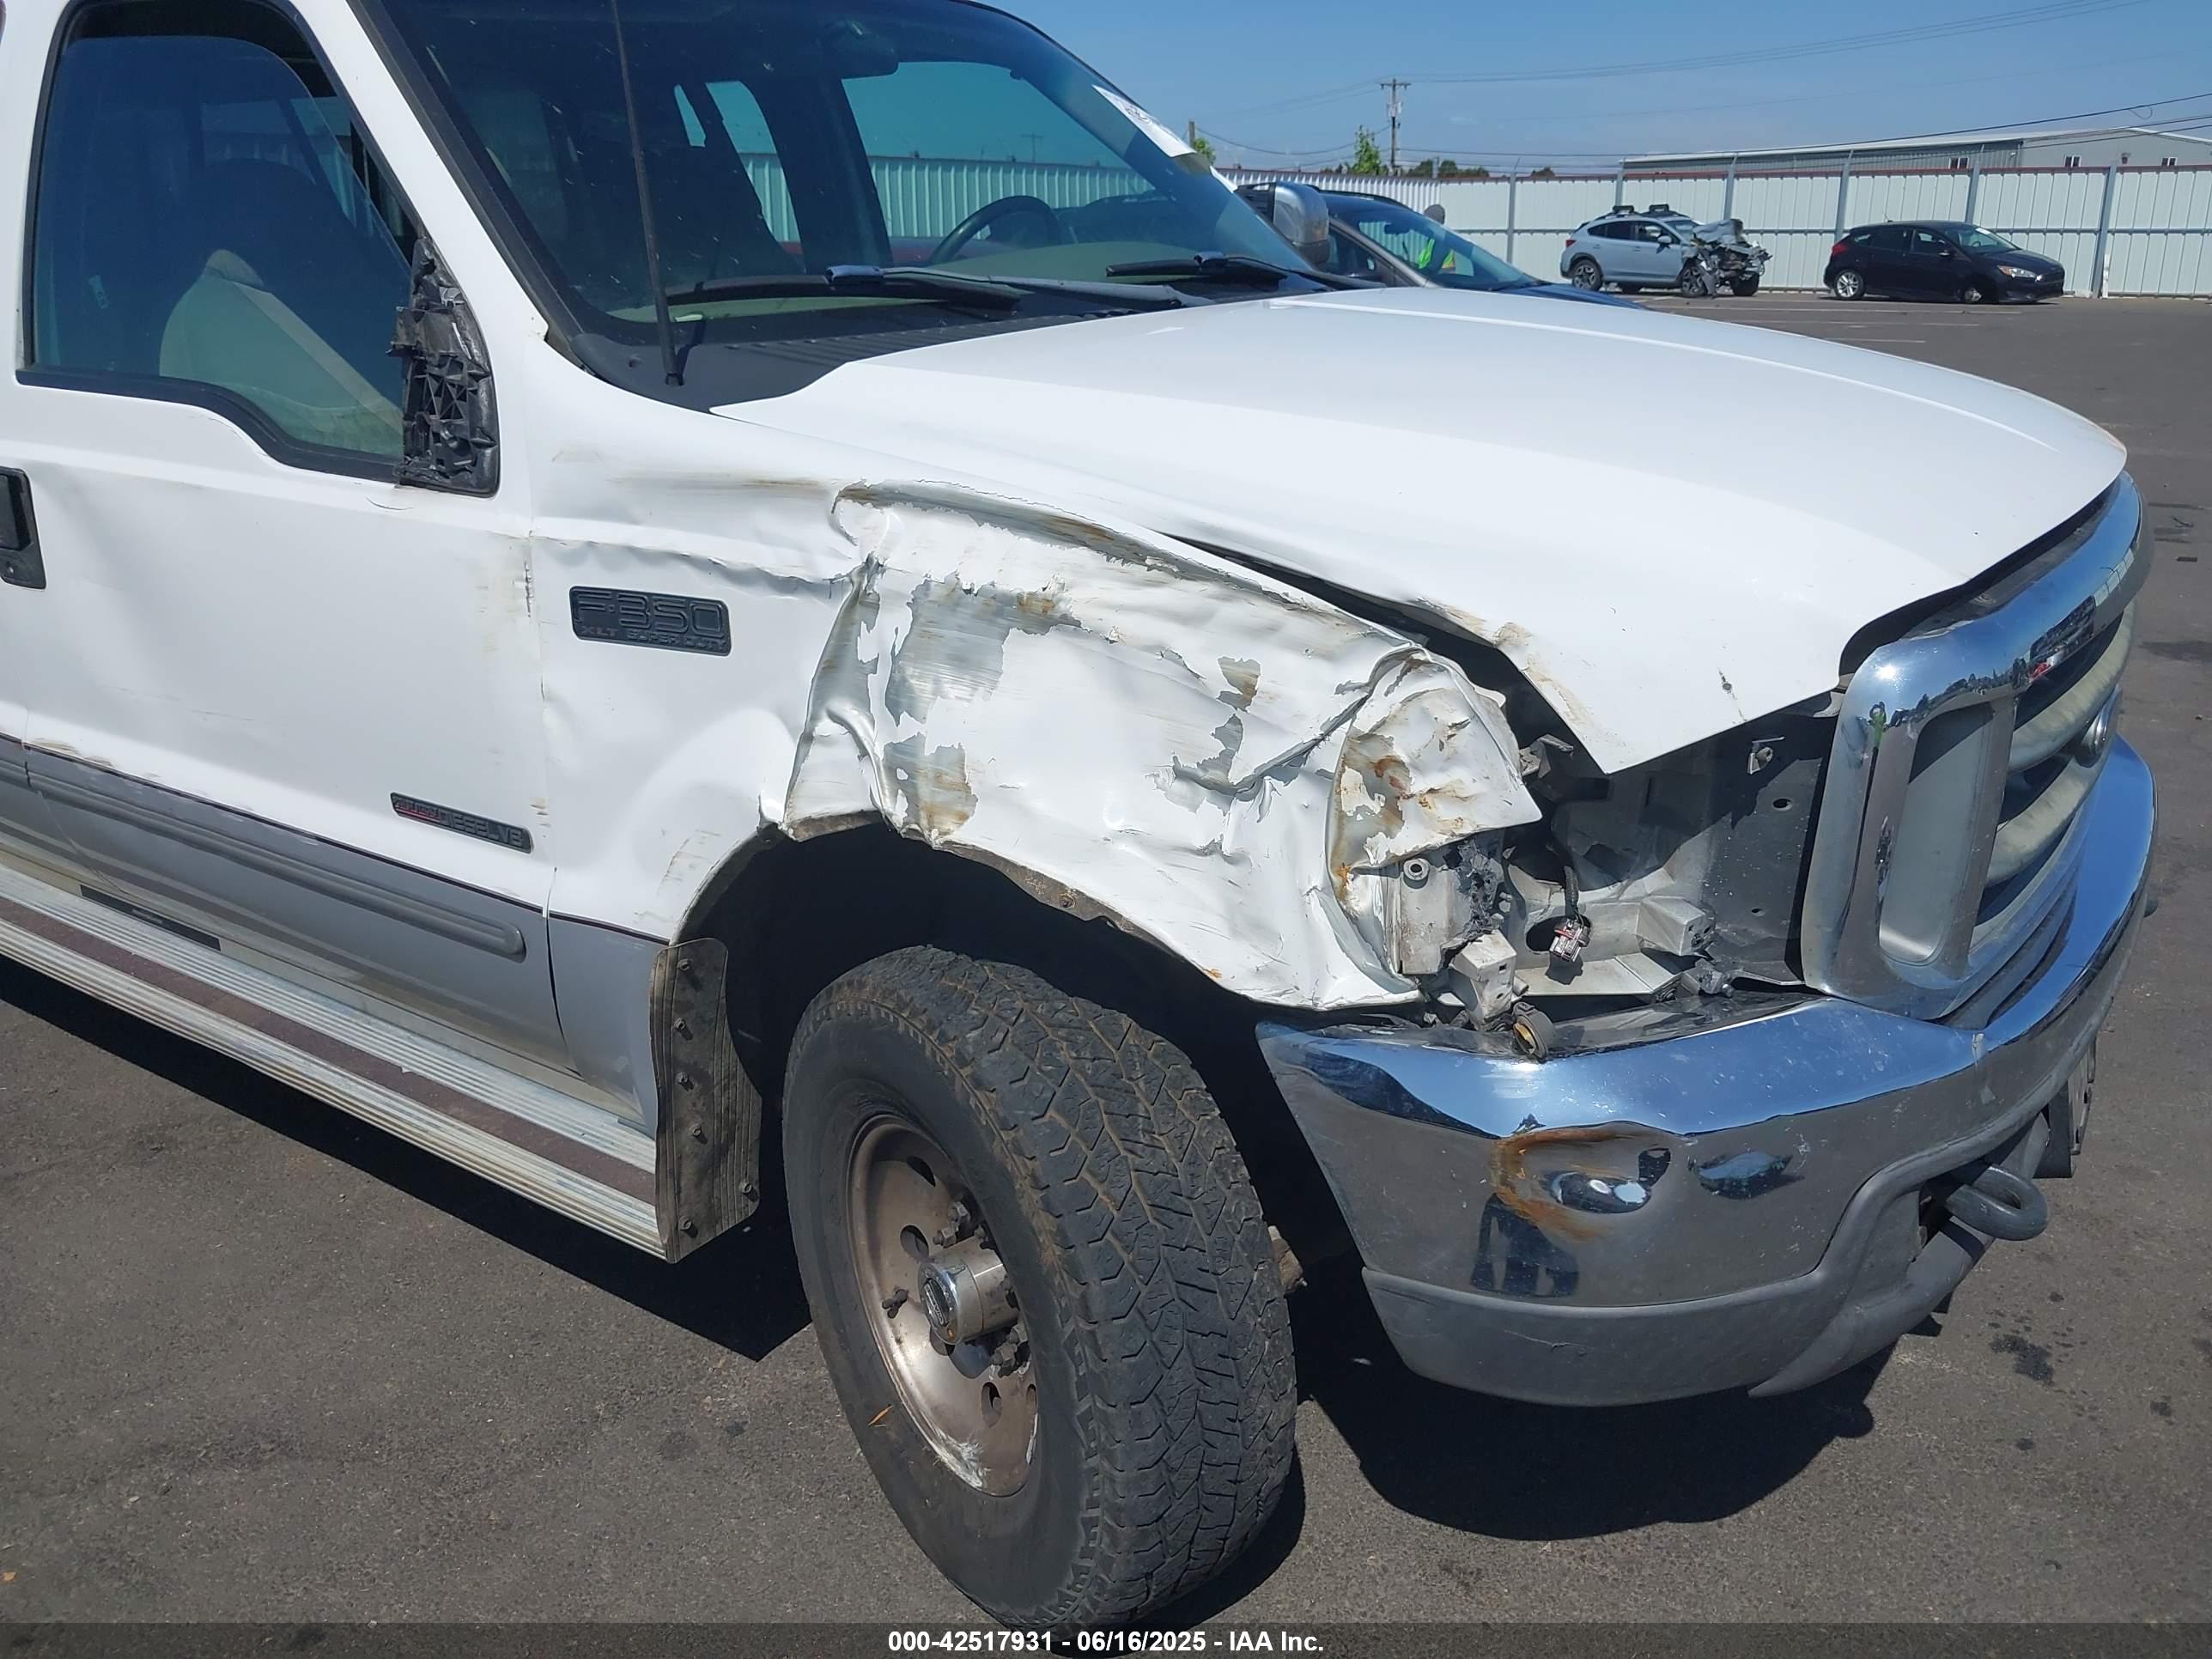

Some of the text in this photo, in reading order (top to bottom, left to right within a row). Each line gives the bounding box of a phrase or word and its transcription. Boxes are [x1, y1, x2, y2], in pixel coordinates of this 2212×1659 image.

[580, 626, 727, 653] XLT SUPER DUTY
